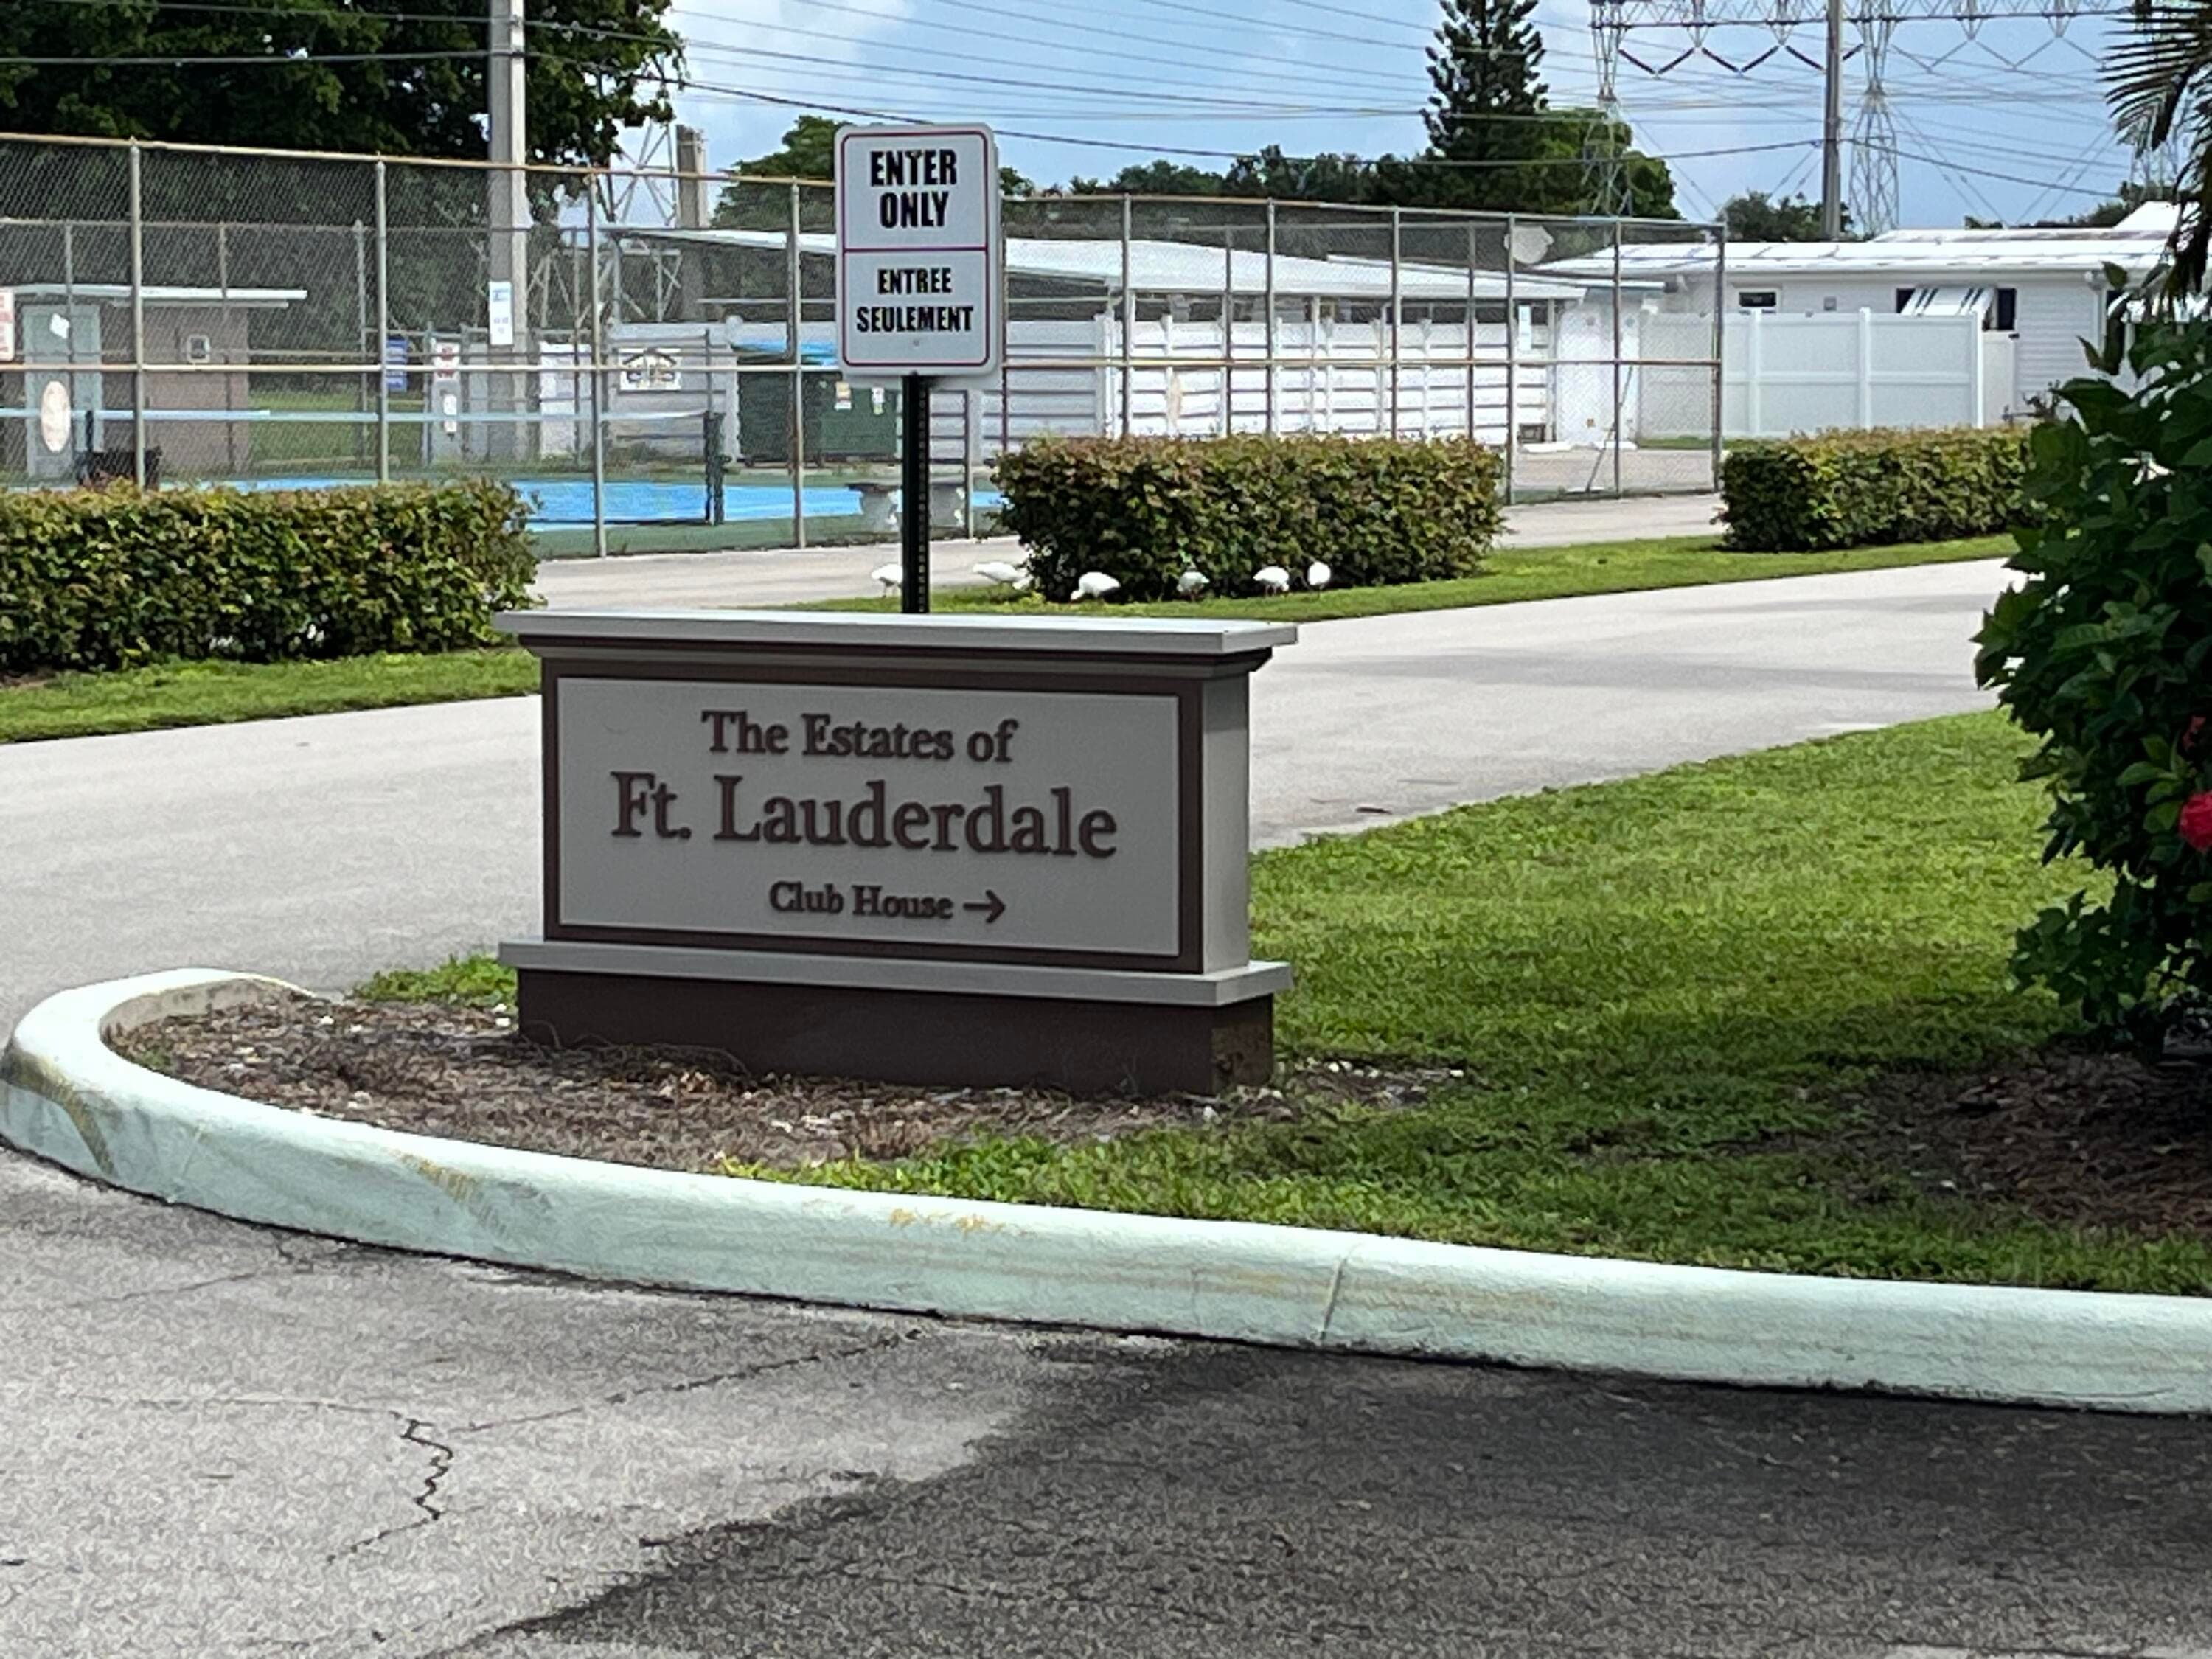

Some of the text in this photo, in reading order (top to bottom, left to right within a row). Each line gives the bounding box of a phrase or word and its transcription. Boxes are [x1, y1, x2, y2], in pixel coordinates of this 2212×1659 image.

[869, 149, 957, 187] ENTER
[880, 191, 949, 228] ONLY
[877, 267, 952, 295] ENTREE
[856, 306, 974, 333] SEULEMENT
[701, 709, 1019, 763] The Estates of
[610, 771, 1118, 860] Ft. Lauderdale
[769, 881, 953, 920] Club House
